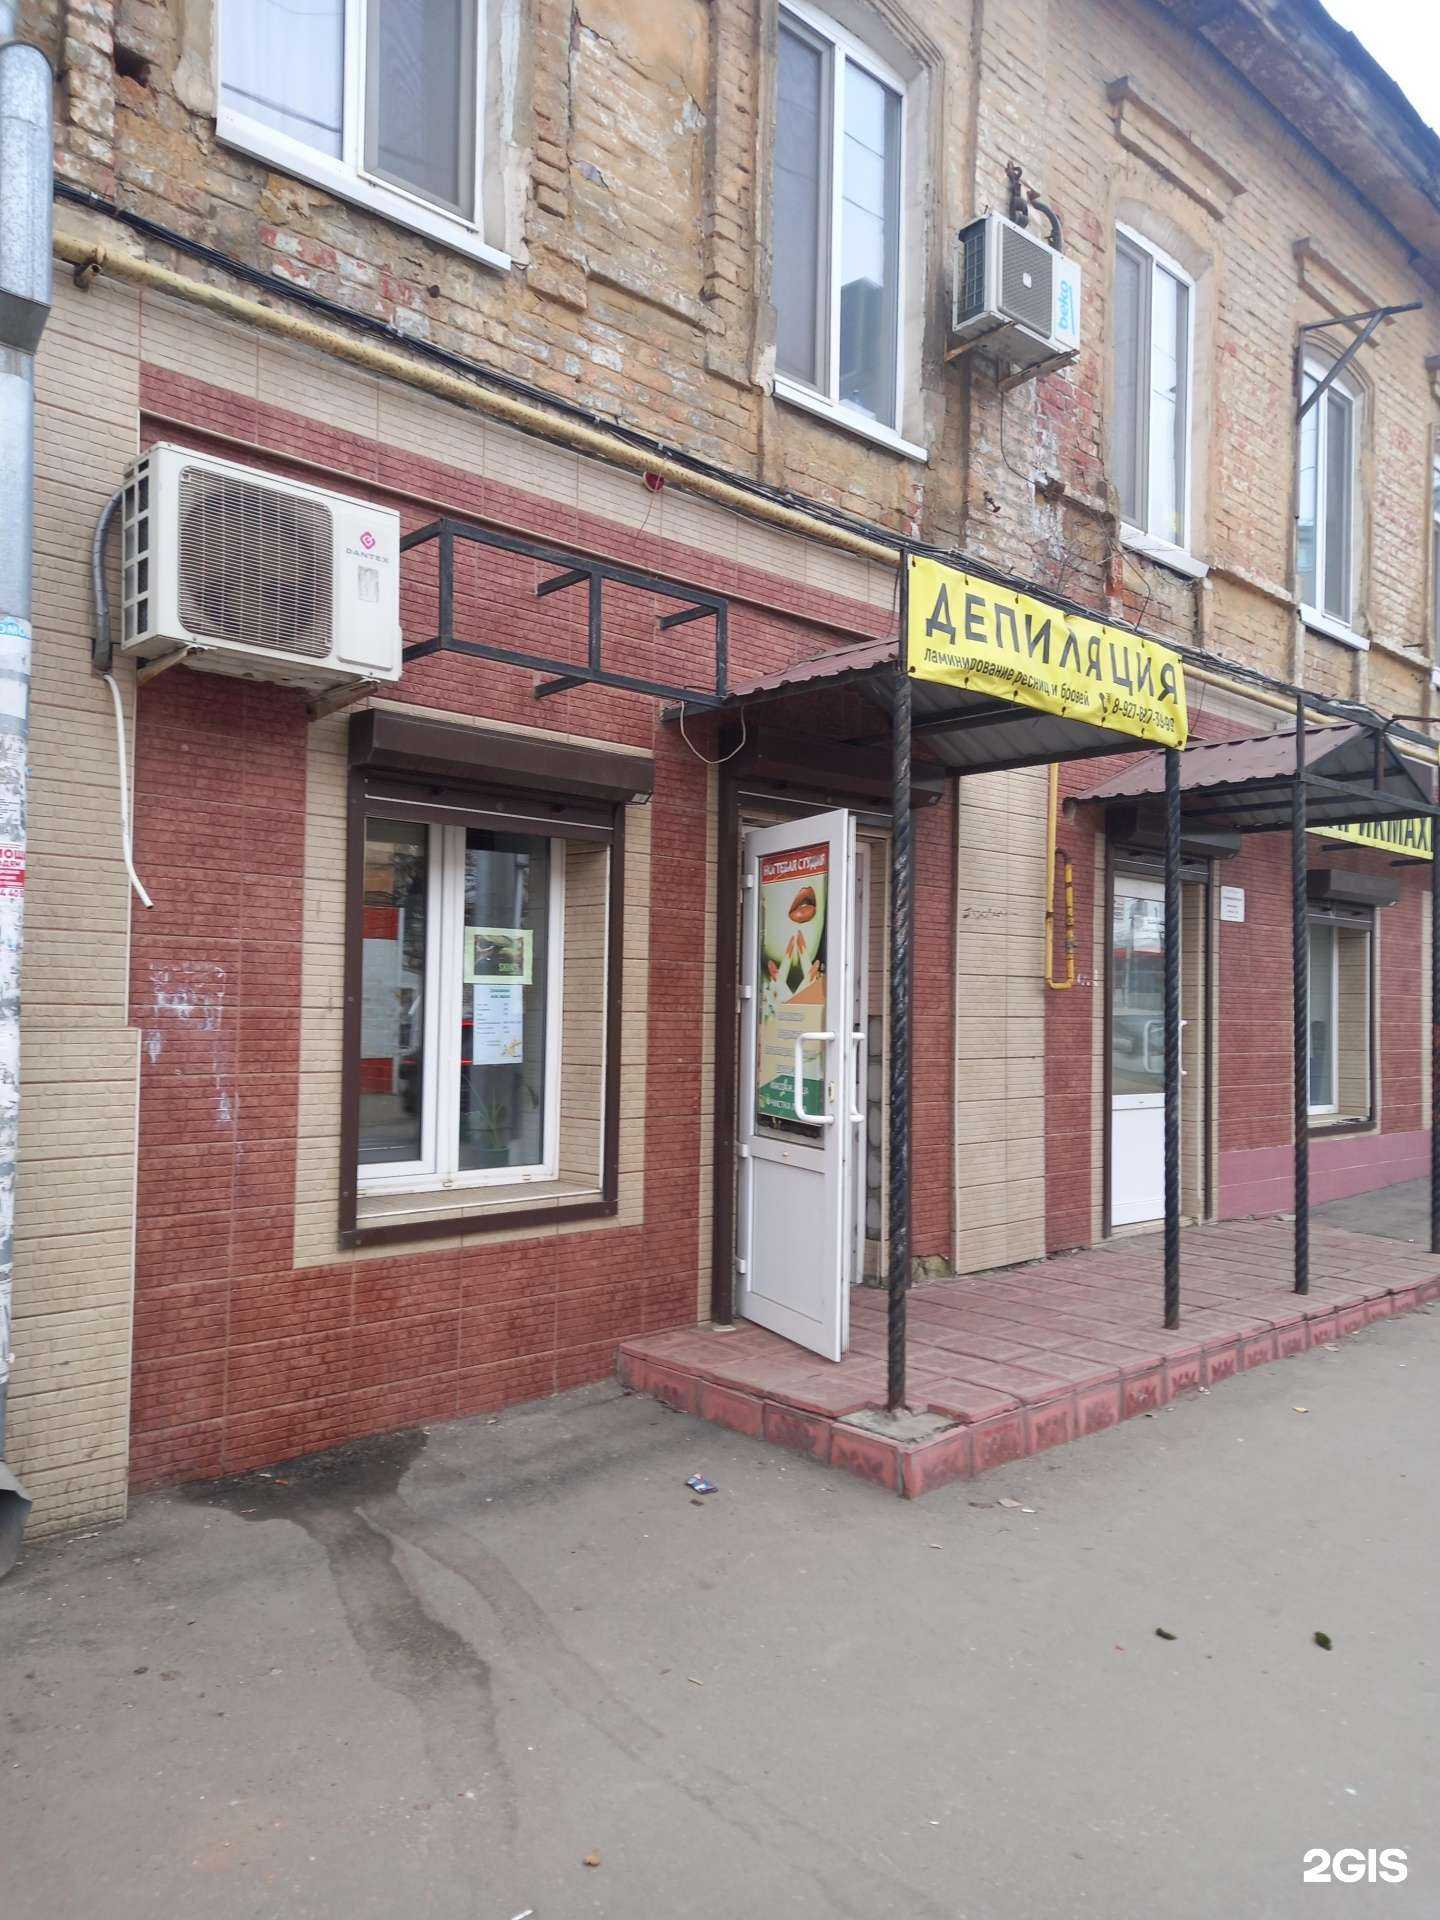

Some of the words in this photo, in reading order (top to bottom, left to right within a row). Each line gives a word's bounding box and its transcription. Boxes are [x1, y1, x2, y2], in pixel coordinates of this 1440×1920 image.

[345, 547, 390, 563] DANTEX
[925, 582, 1179, 704] ДЕПИЛЯЦИЯ
[923, 647, 1015, 681] ламинирование
[1011, 669, 1052, 697] ресниц
[1060, 682, 1090, 707] бровей
